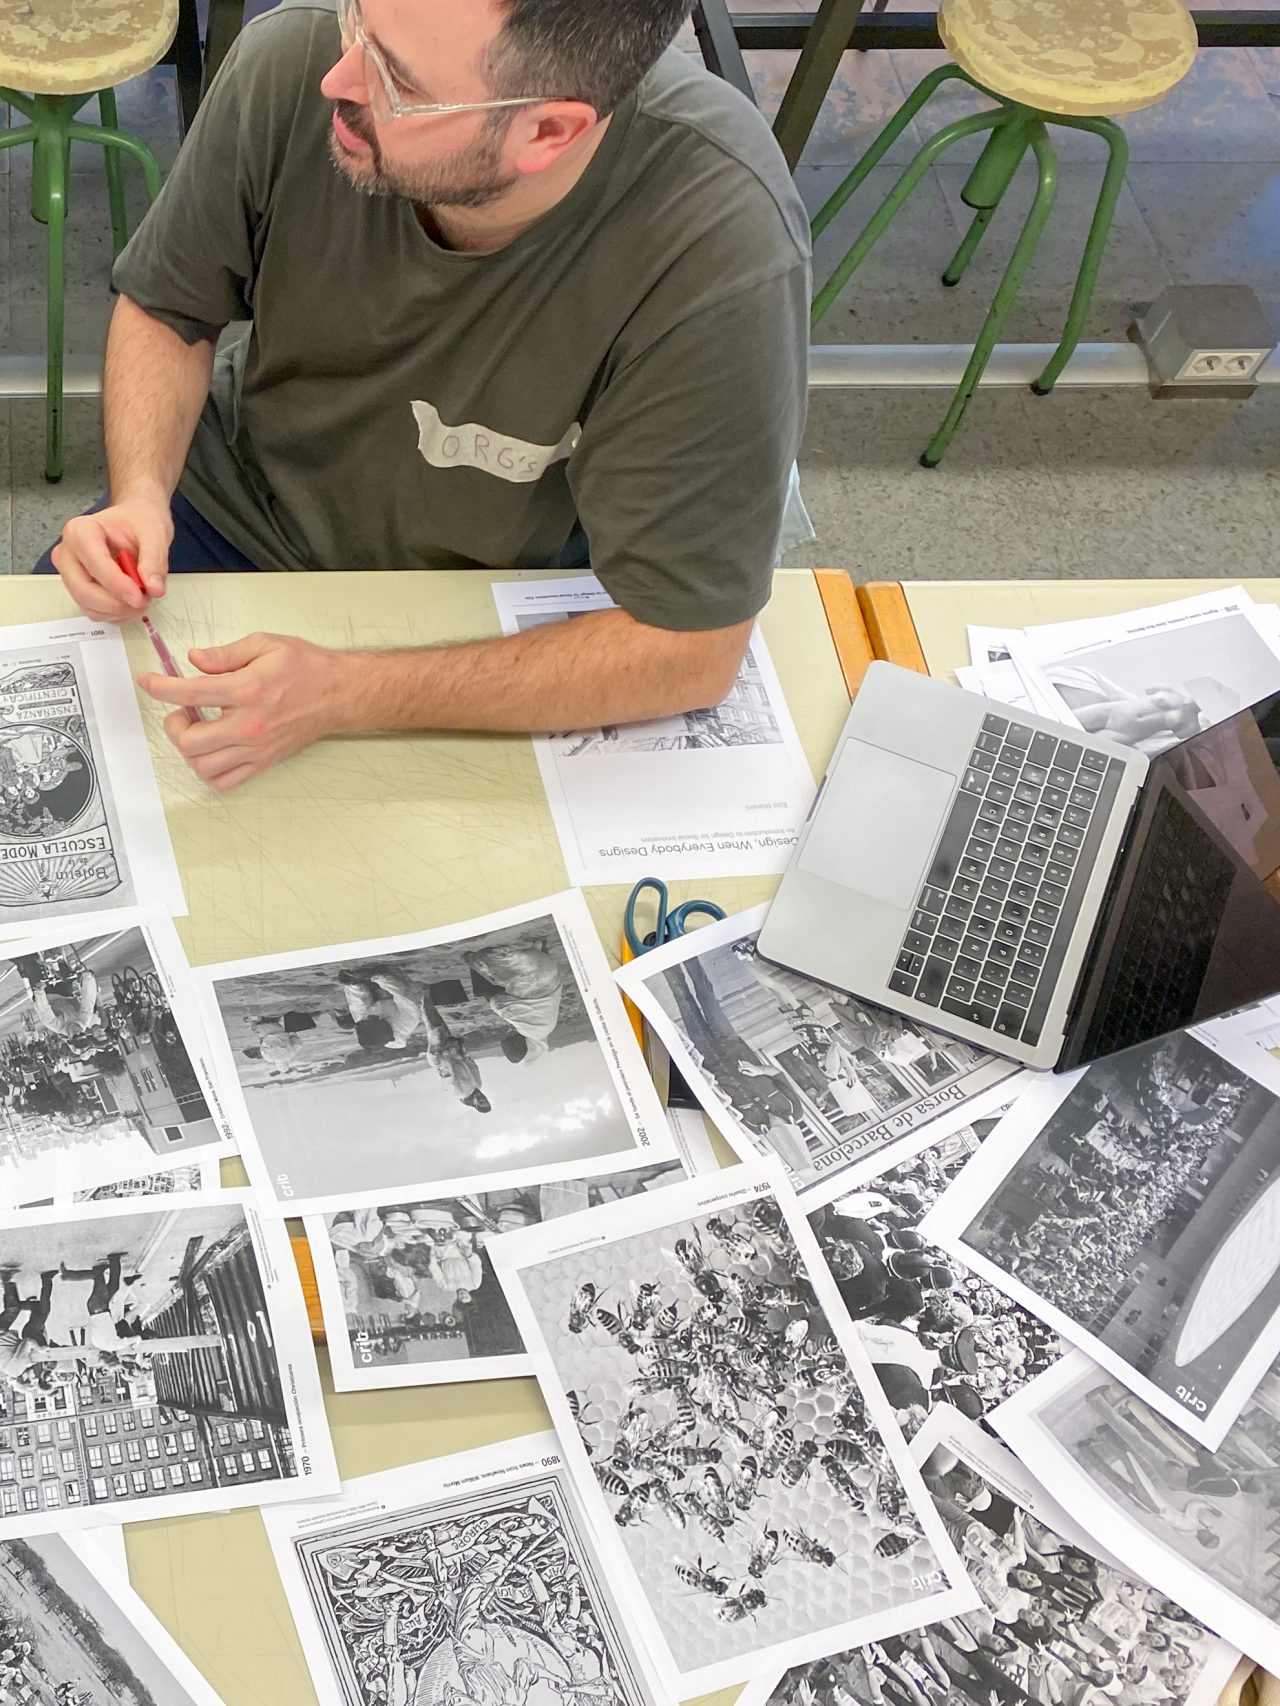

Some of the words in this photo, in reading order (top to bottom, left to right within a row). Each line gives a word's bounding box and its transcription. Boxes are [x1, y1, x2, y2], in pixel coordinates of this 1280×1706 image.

[42, 835, 105, 855] ESCUELA
[598, 844, 648, 858] Designs
[650, 841, 714, 854] Everybody
[716, 840, 750, 850] When
[914, 1083, 967, 1113] Borsa
[890, 1109, 915, 1133] de
[636, 1126, 650, 1147] 2002
[812, 1123, 894, 1172] Barcelona
[752, 1181, 771, 1193] 1974
[286, 1363, 297, 1394] Christiania
[298, 1426, 306, 1447] Primera
[300, 1455, 312, 1475] 1970
[518, 1461, 533, 1469] News
[540, 1454, 560, 1466] 1890
[442, 1479, 460, 1488] Morris
[460, 1474, 479, 1484] William
